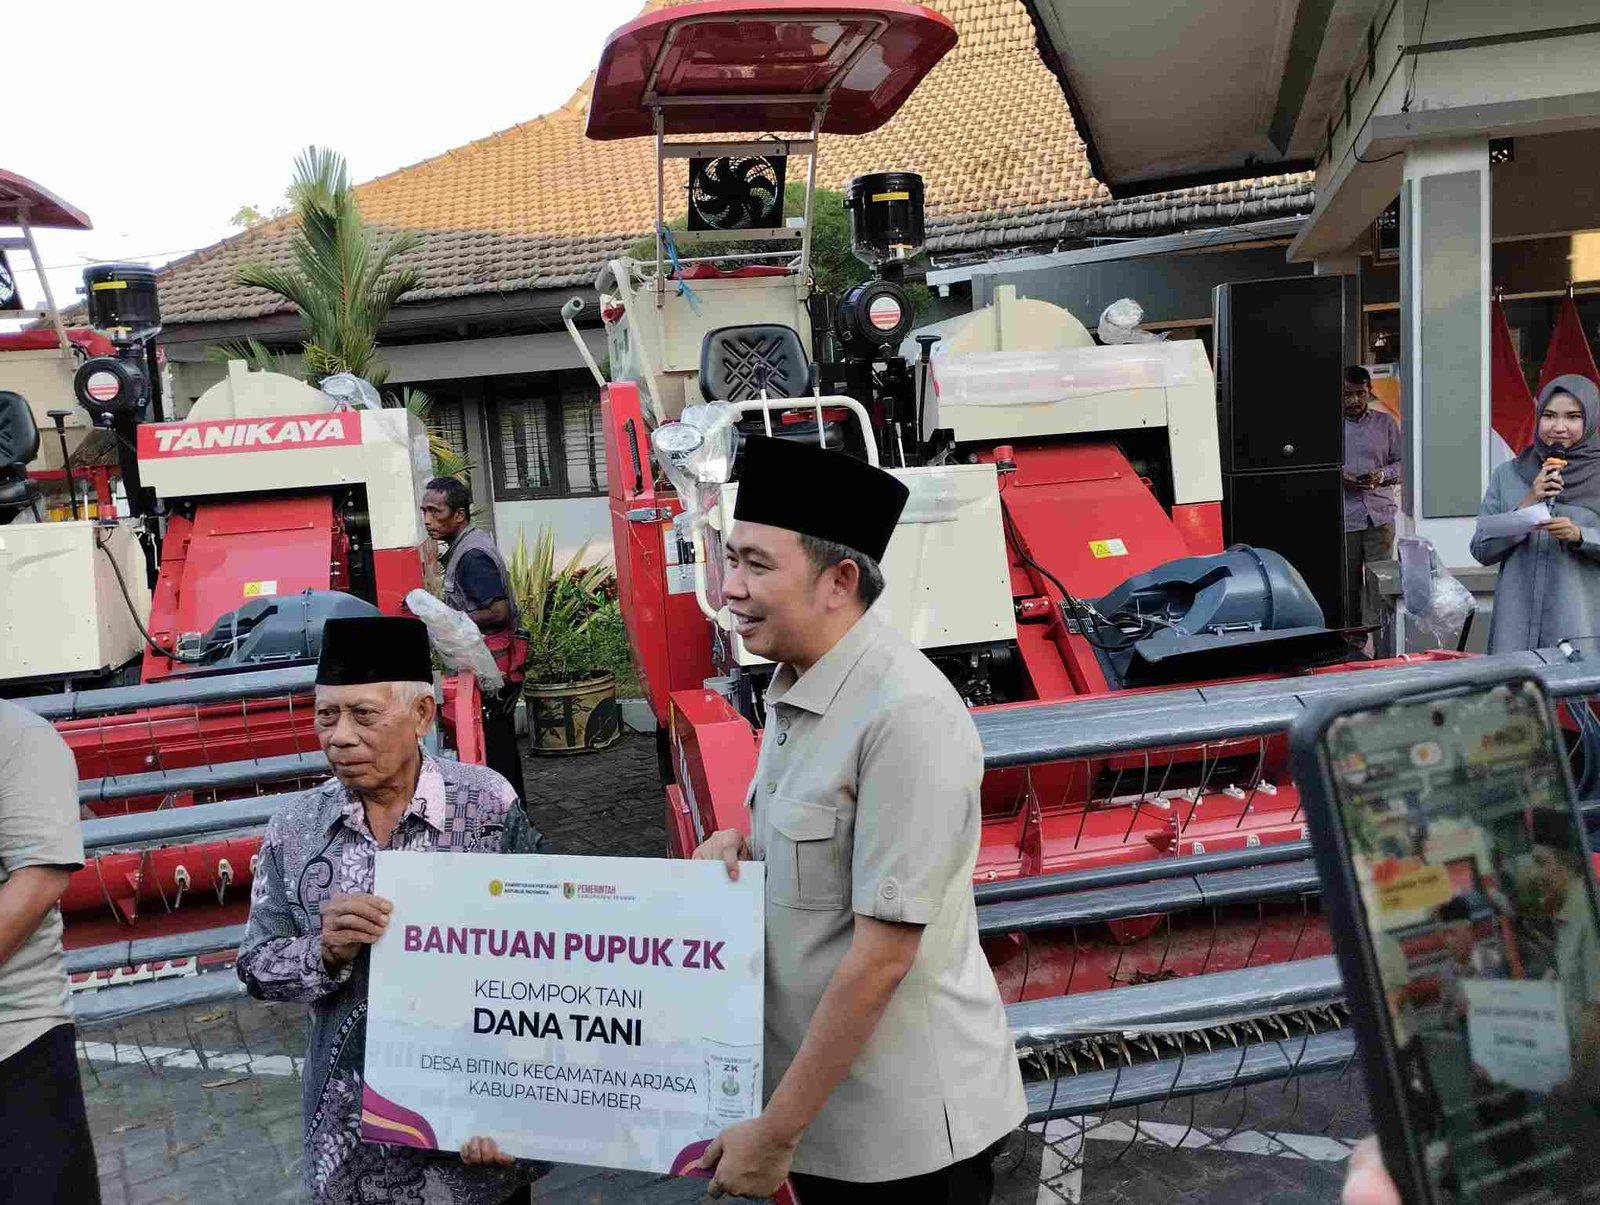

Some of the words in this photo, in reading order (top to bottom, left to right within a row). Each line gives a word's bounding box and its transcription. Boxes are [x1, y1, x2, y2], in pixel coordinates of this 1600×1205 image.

[155, 418, 345, 452] TANIKAYA
[577, 884, 616, 895] PEMERINTAH
[404, 925, 555, 960] BANTUAN
[564, 933, 674, 967] PUPUK
[682, 940, 726, 970] ZK
[474, 979, 593, 1005] KELOMPOK
[595, 986, 642, 1009] TANI
[473, 1007, 563, 1040] DANA
[569, 1014, 642, 1047] TANI
[421, 1054, 463, 1073] DESA
[467, 1057, 519, 1078] BITING
[522, 1061, 626, 1087] KECAMATAN
[631, 1071, 697, 1094] ARJASA
[723, 1064, 739, 1073] ZK
[469, 1080, 569, 1104] KABUPATEN
[573, 1089, 642, 1111] JEMBER
